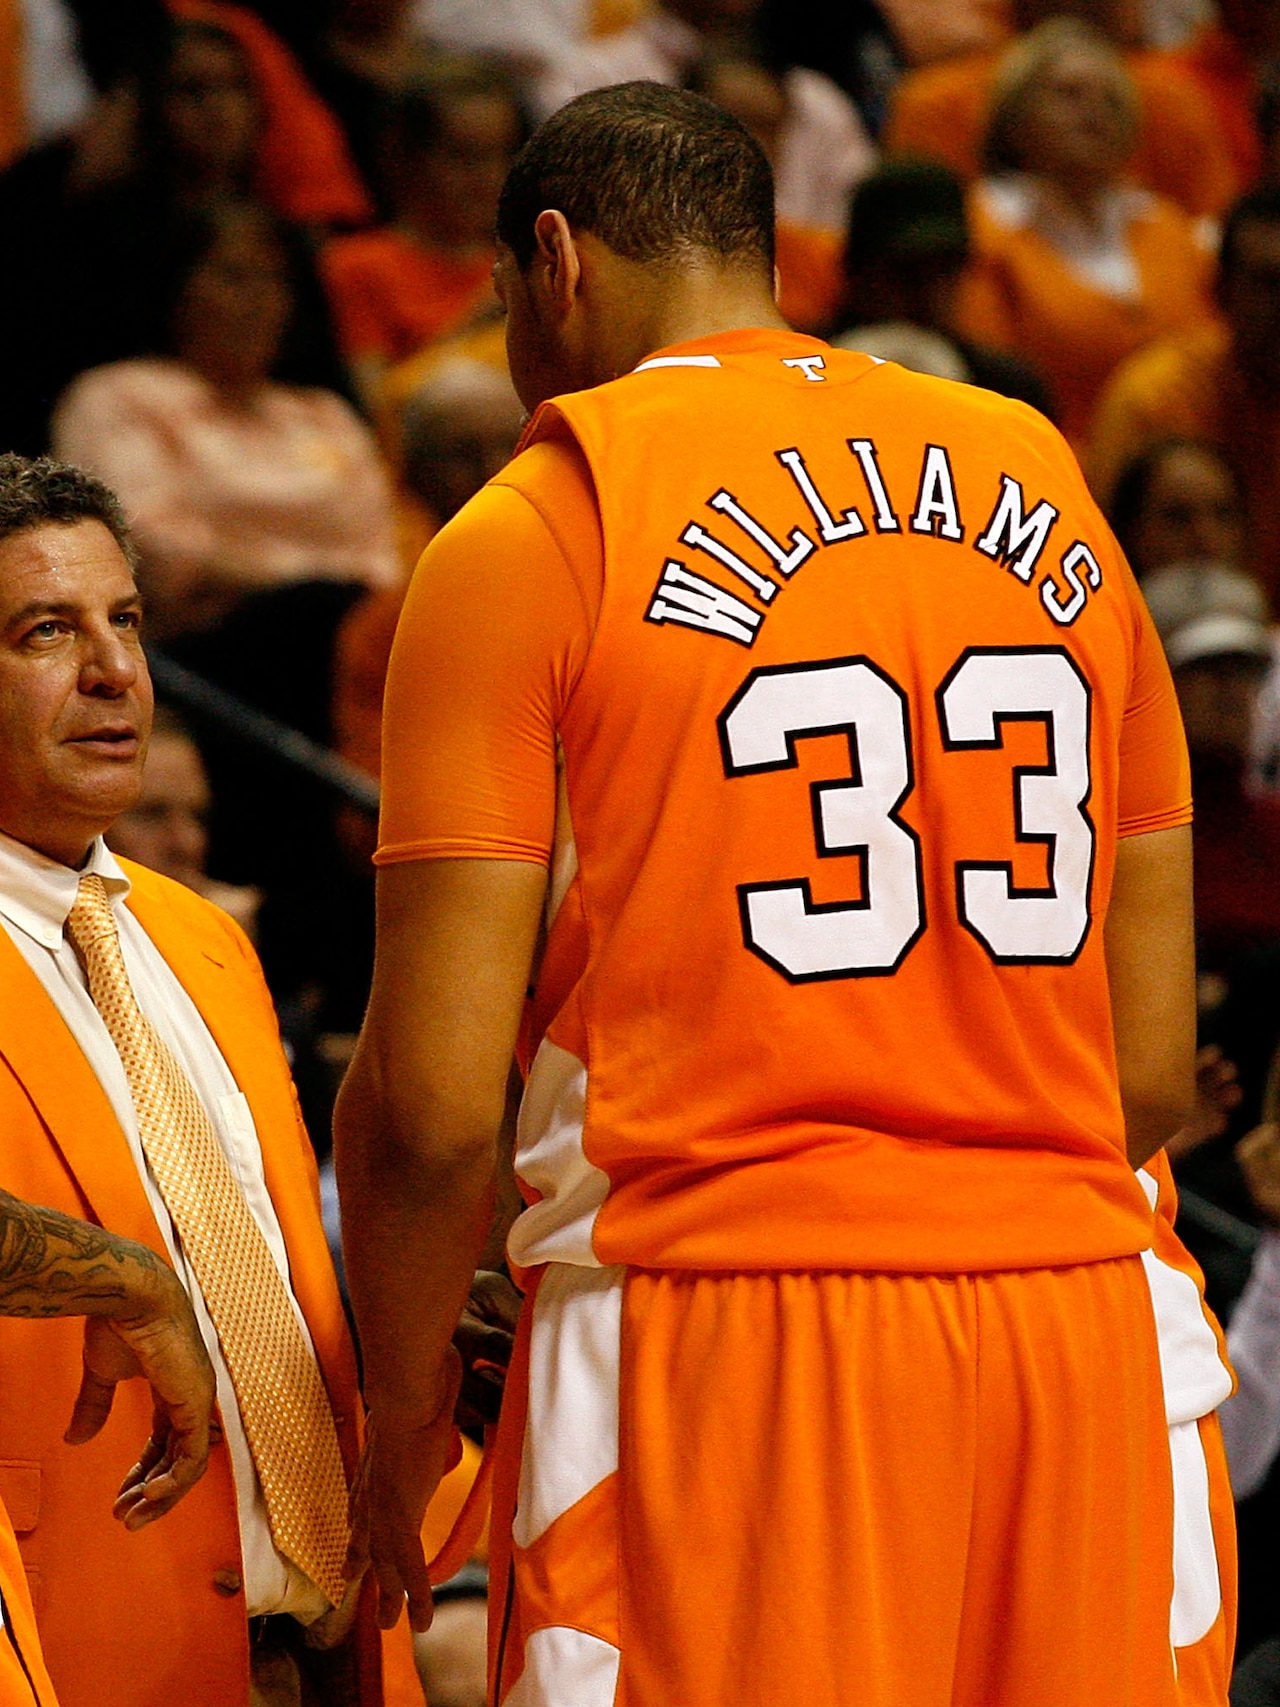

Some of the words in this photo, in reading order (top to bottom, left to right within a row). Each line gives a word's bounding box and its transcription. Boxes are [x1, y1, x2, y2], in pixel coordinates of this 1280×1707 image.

[779, 353, 827, 382] T
[644, 437, 1103, 649] WILLIAMS
[716, 644, 1097, 985] 33
